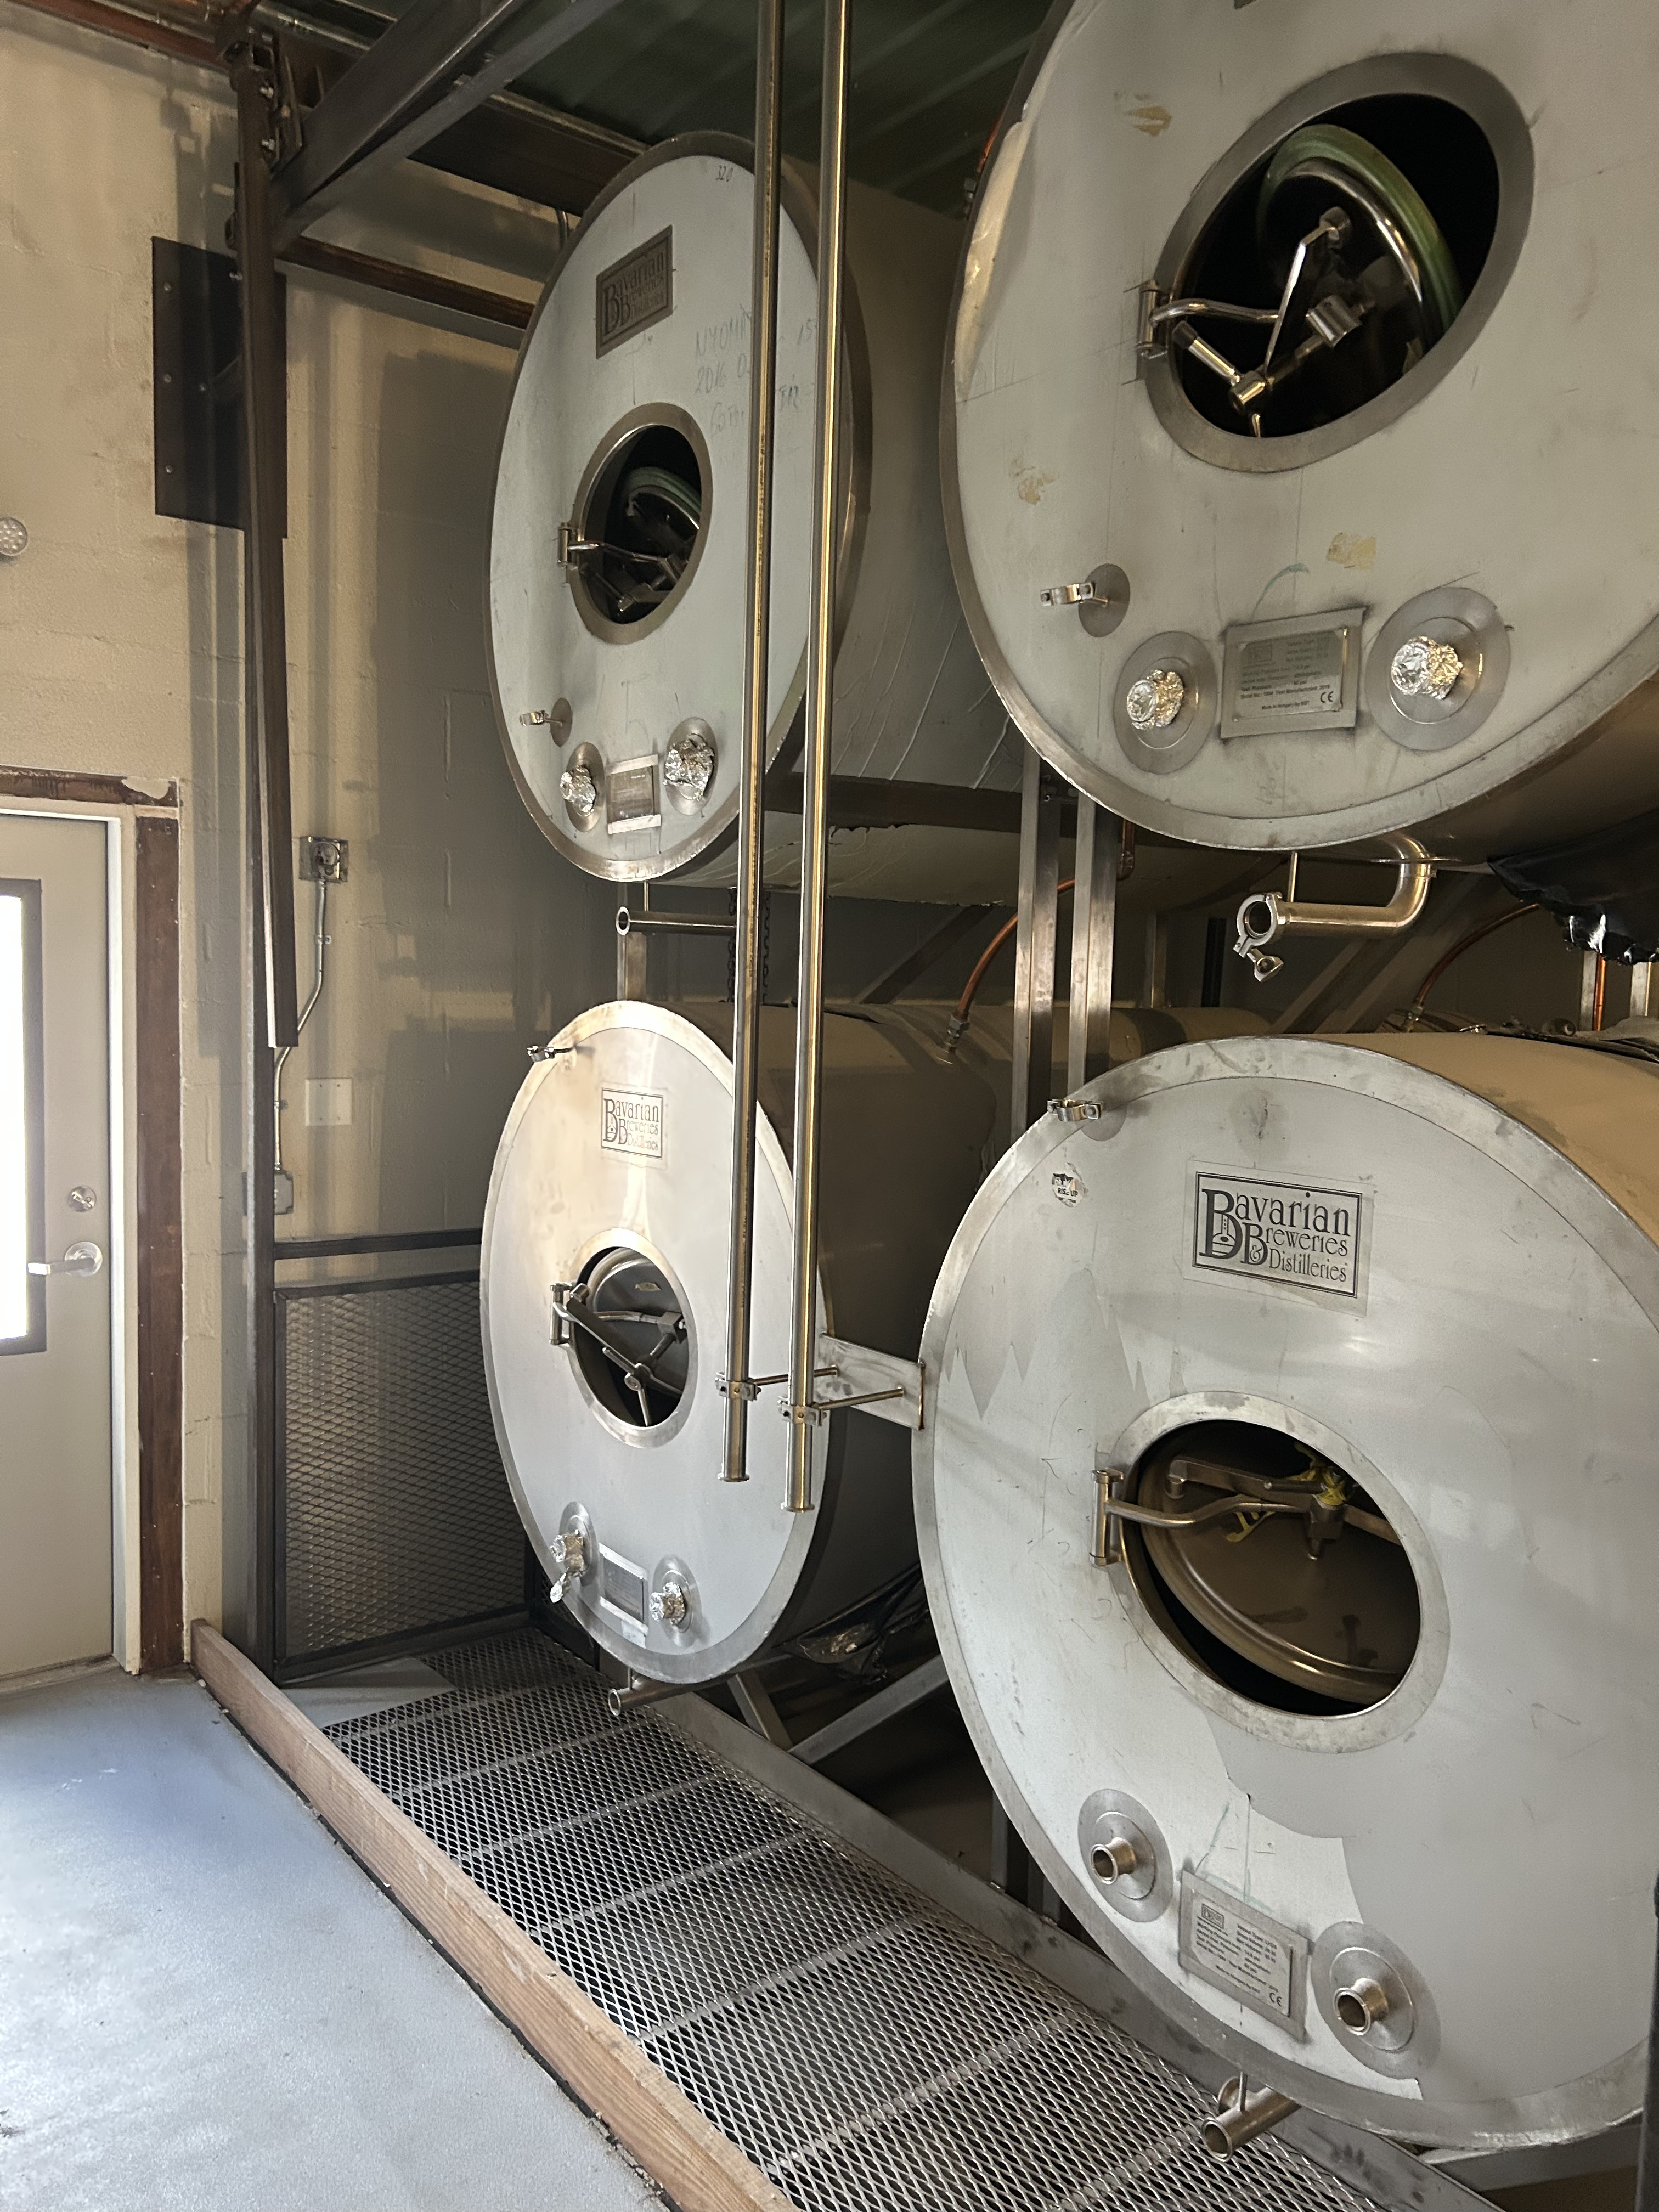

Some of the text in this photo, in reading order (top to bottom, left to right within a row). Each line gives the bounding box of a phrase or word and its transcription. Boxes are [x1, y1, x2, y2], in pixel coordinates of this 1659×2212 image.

[603, 1097, 659, 1142] Bavarian
[1199, 1188, 1351, 1259] Bavarian
[1240, 1222, 1348, 1266] Breweries
[1269, 1248, 1347, 1282] Distilleries
